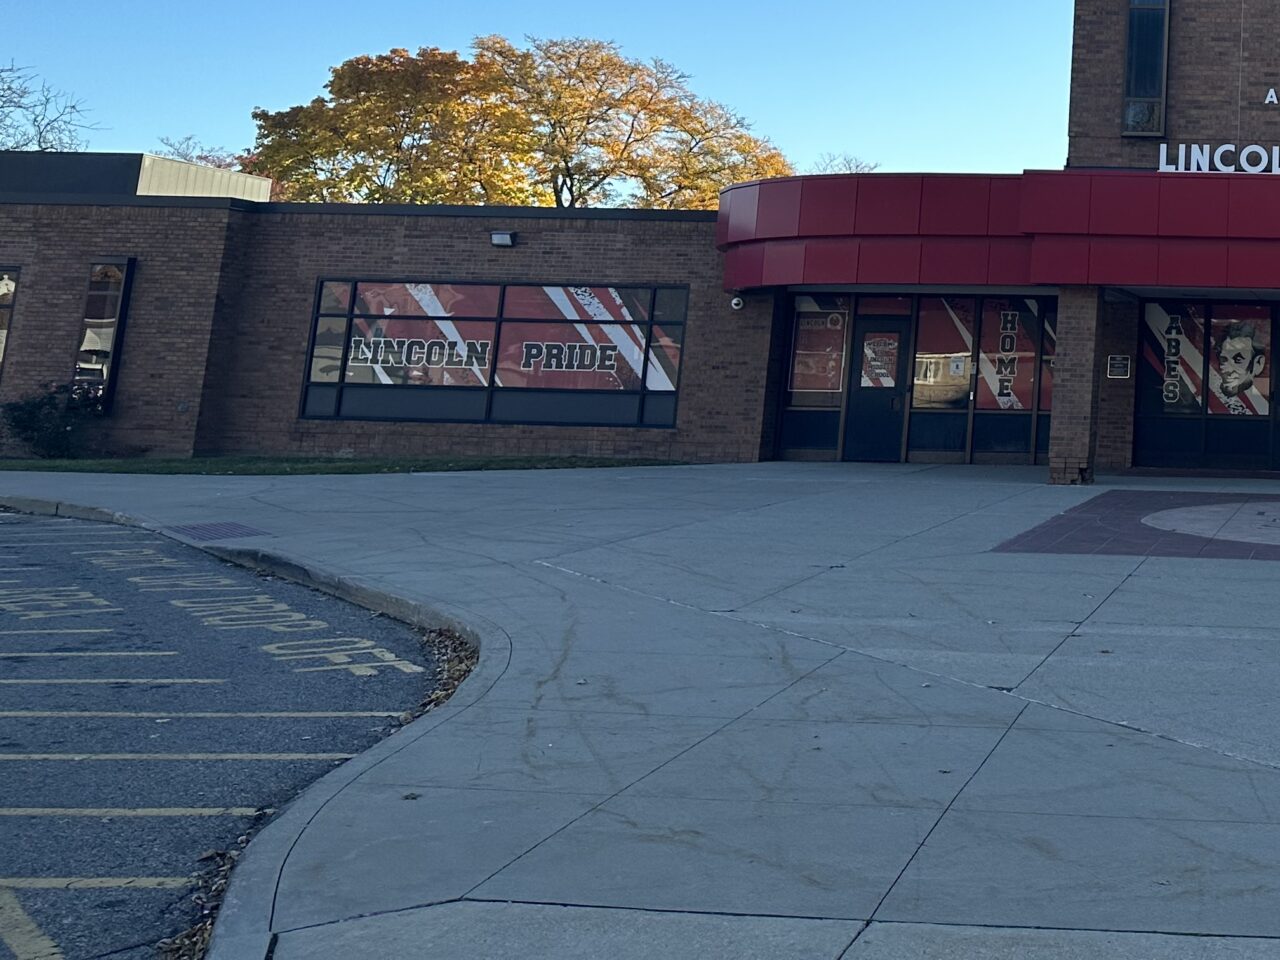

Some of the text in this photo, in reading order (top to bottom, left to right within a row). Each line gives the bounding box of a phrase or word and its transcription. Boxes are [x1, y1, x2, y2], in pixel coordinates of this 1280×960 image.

[1264, 88, 1279, 105] A
[348, 338, 620, 373] LINCOLN PRIDE
[996, 311, 1019, 398] HOME
[1162, 314, 1185, 403] ABES
[170, 594, 329, 632] DROP
[260, 637, 425, 676] OFF
